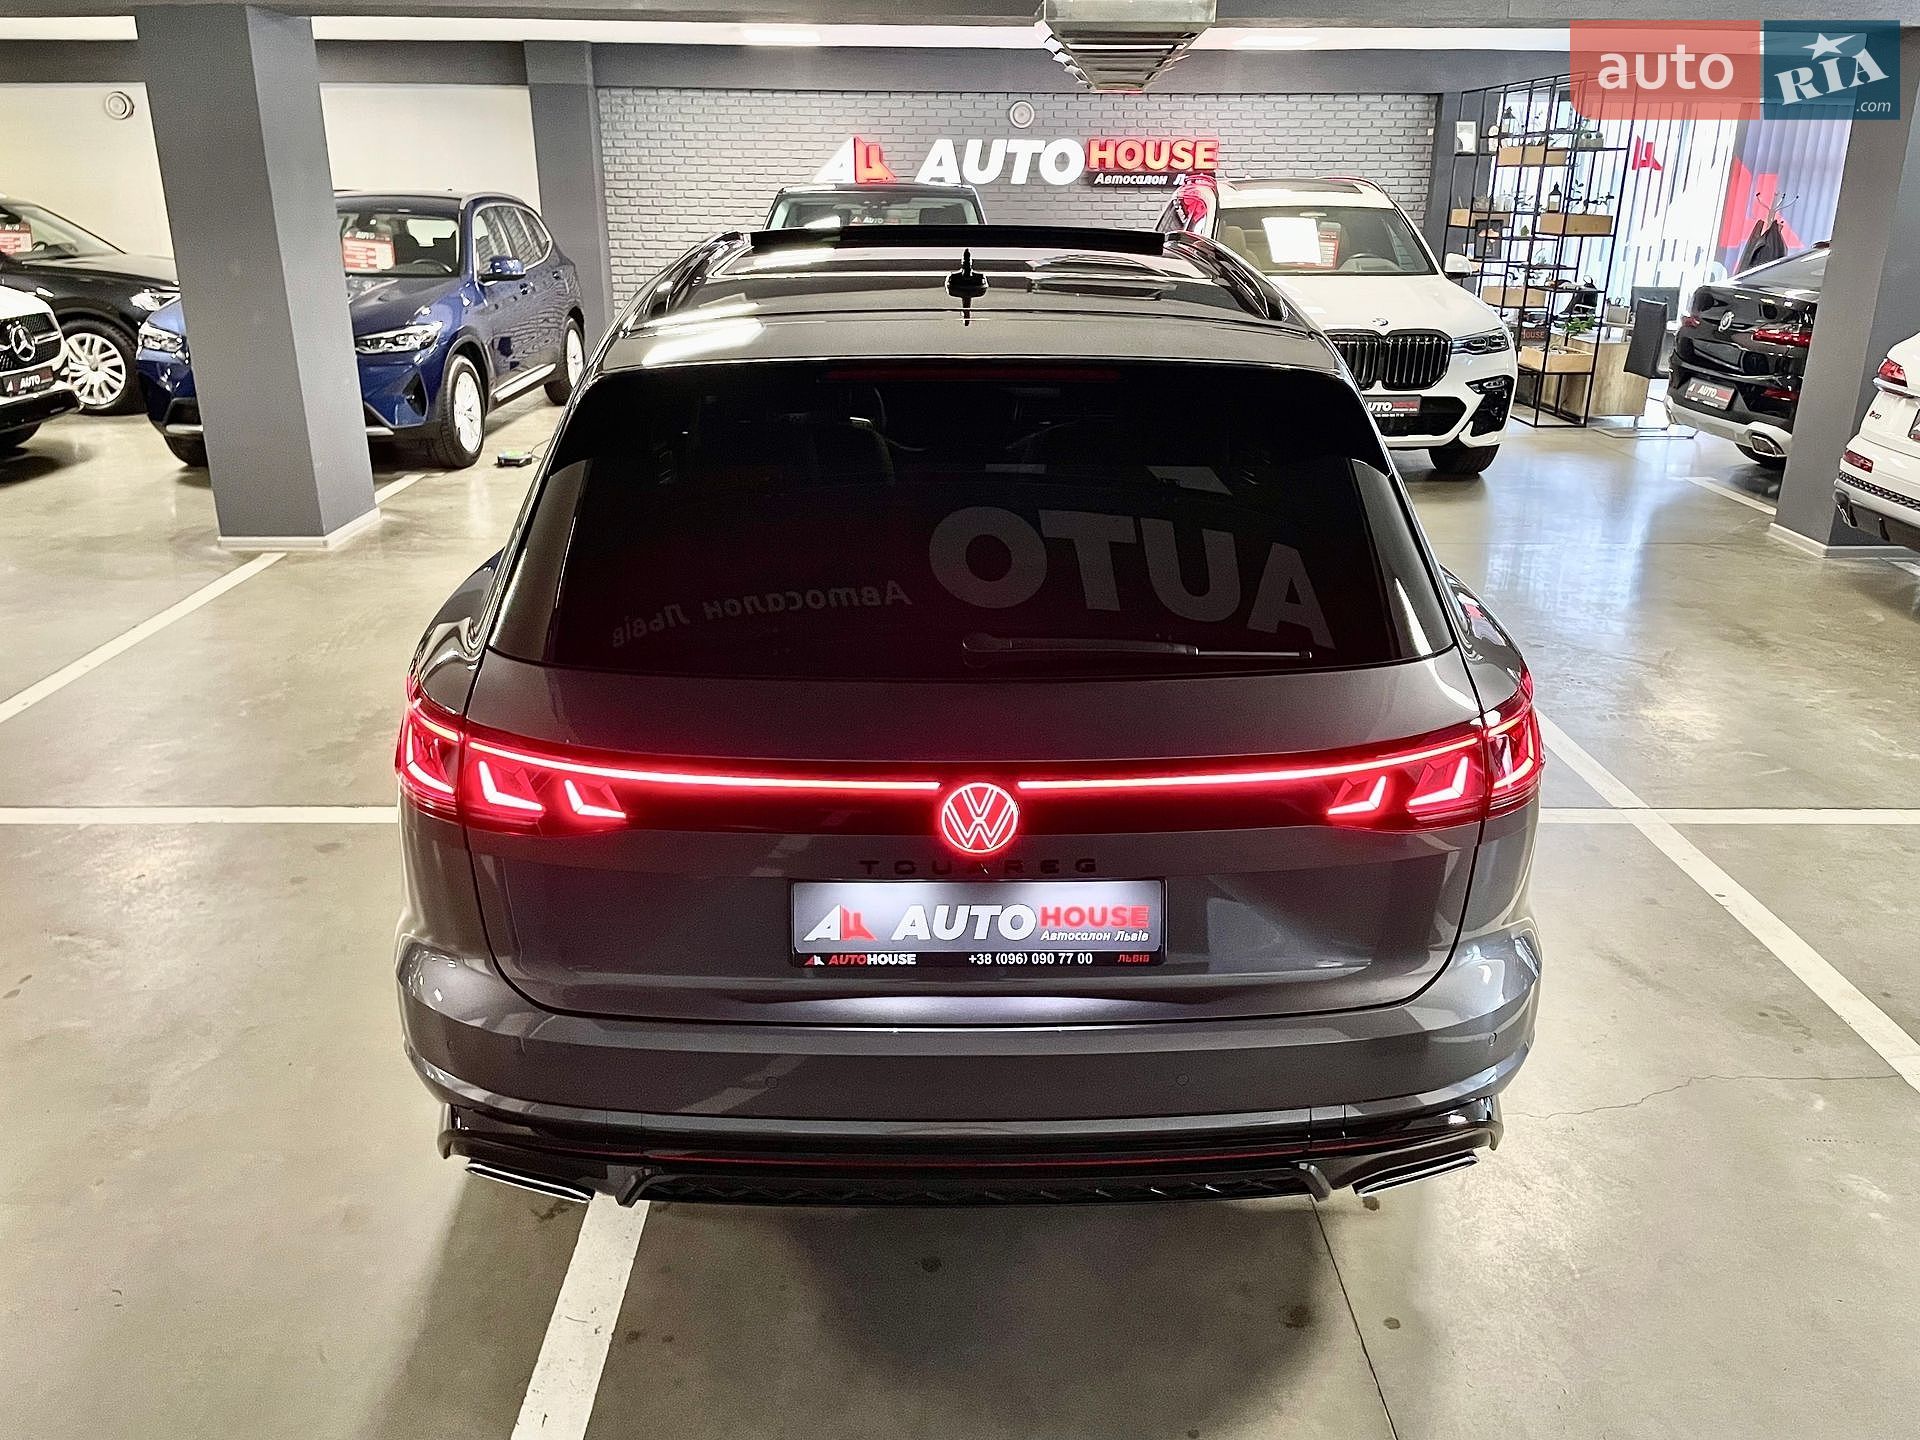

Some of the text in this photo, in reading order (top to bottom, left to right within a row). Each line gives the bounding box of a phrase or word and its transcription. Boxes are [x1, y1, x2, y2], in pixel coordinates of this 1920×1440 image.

[913, 138, 1085, 185] AUTO
[1088, 138, 1218, 171] HOUSE
[1093, 172, 1168, 186] Автосалон
[1366, 401, 1393, 412] UTO
[890, 904, 1037, 941] AUTO
[1040, 905, 1150, 928] HOUSE
[1040, 929, 1150, 942] Автосалон Львів
[968, 953, 993, 965] +38
[995, 952, 1029, 966] (096)
[1031, 952, 1056, 965] 090
[1058, 952, 1075, 965] 77
[1077, 952, 1094, 965] 00
